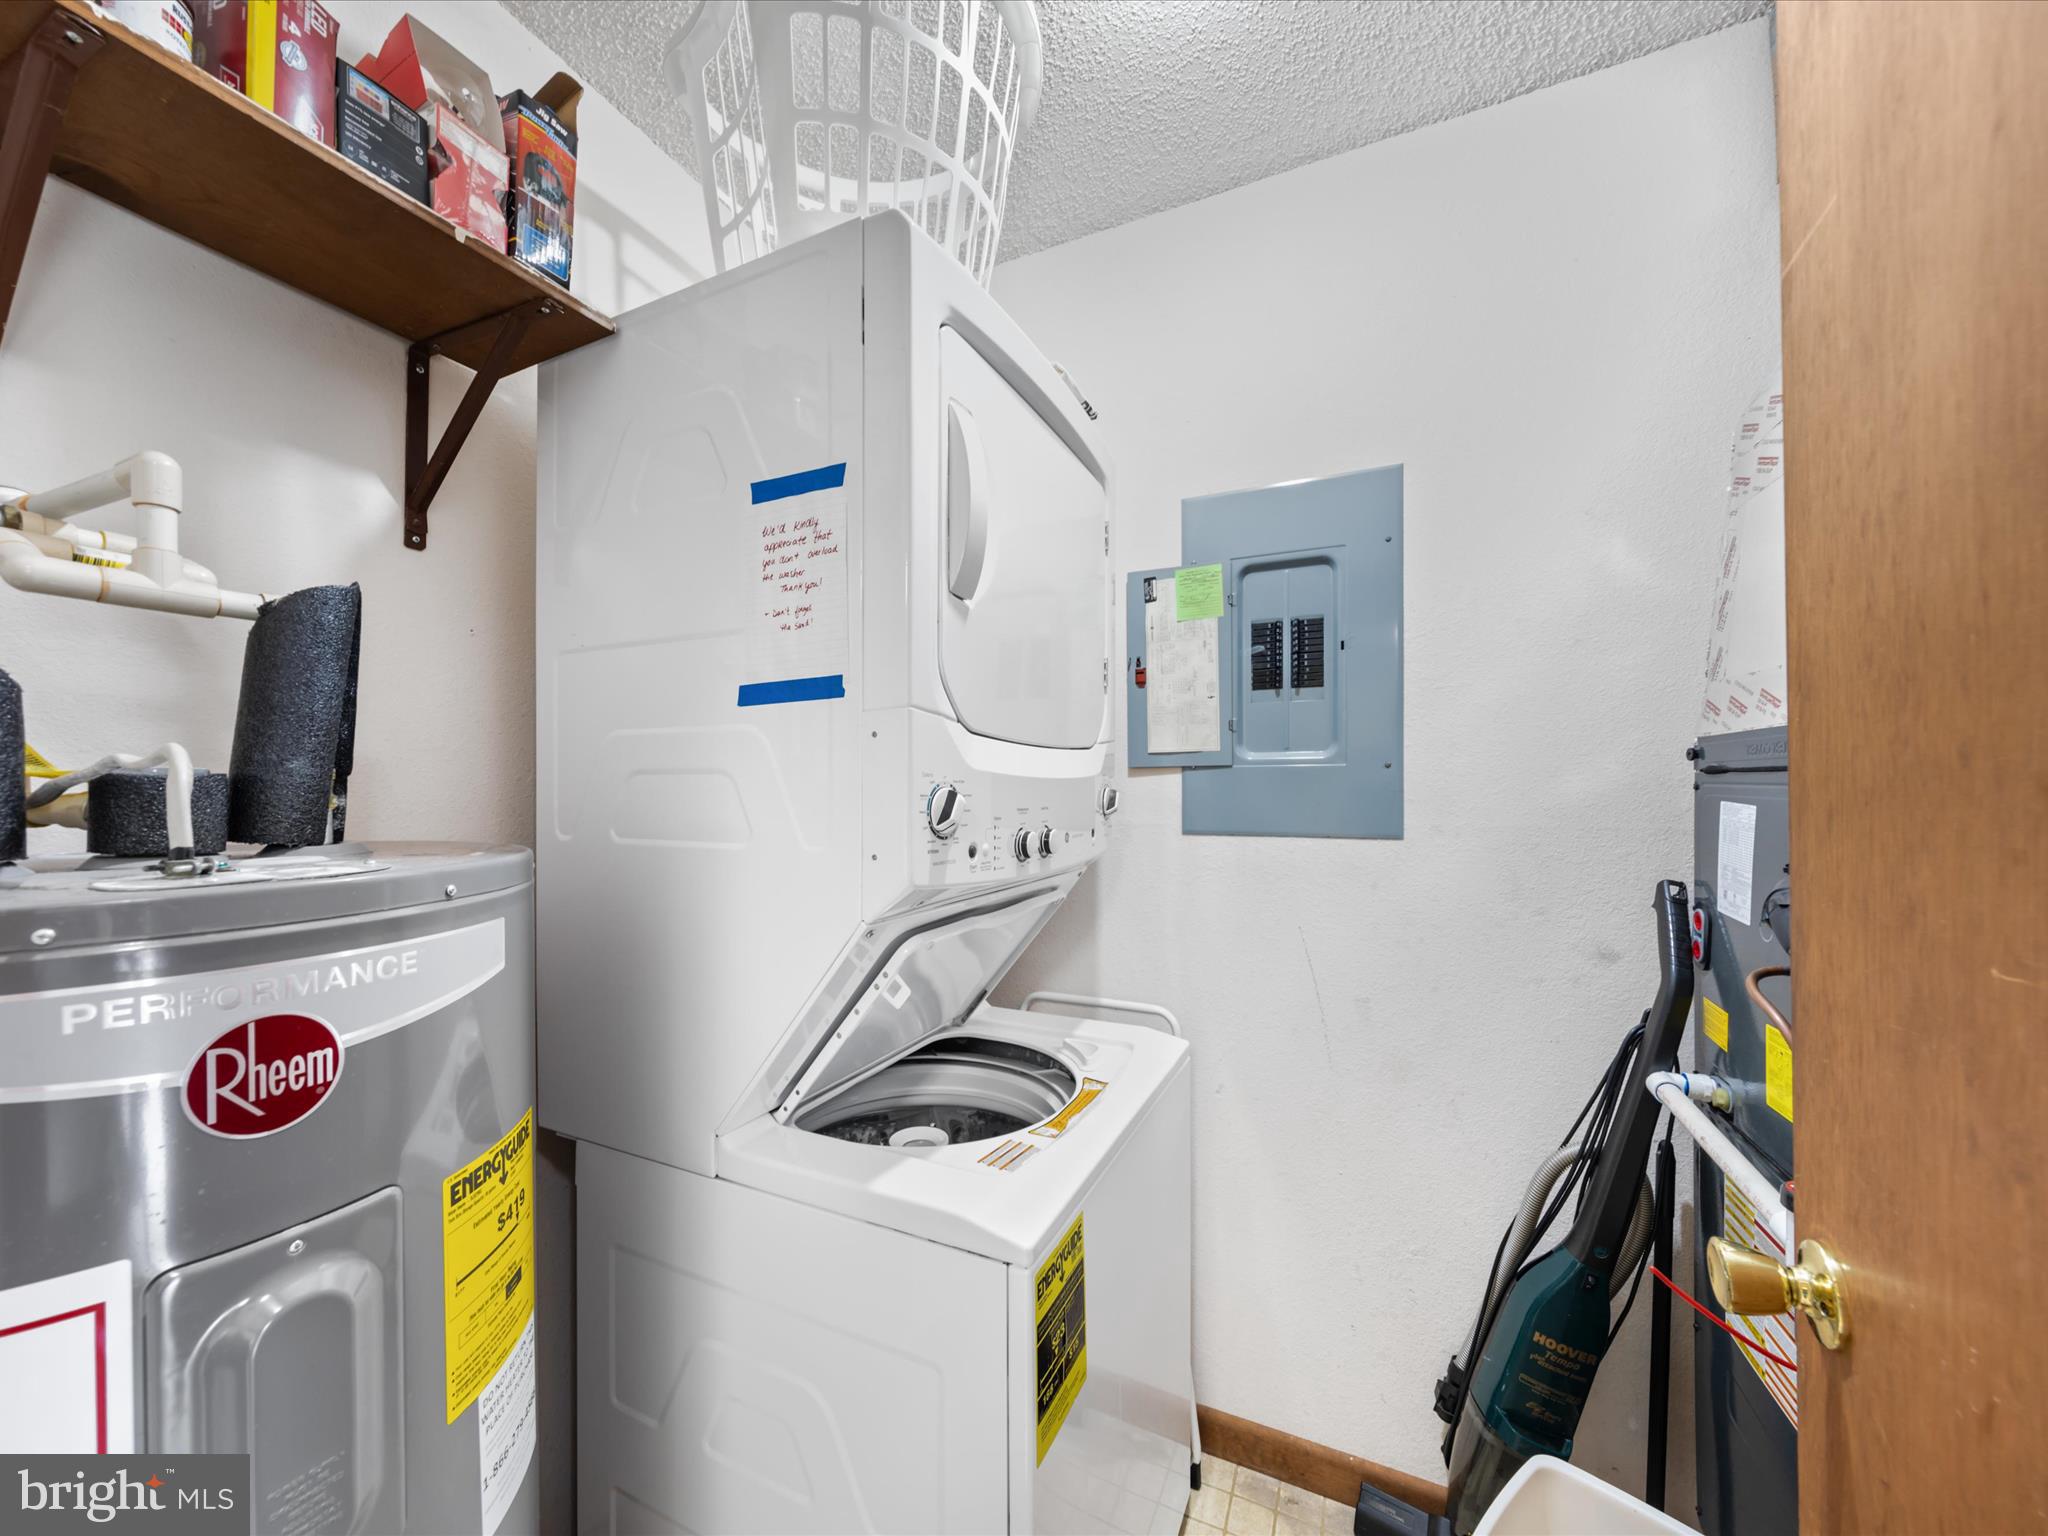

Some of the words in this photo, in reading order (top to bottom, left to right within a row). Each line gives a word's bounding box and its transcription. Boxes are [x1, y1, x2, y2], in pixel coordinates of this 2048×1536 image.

[536, 107, 550, 122] Jig
[550, 118, 568, 137] Saw
[813, 528, 833, 543] that
[762, 559, 775, 572] you
[779, 568, 805, 579] washer
[61, 949, 420, 1036] PERFORMANCE
[205, 1021, 335, 1126] Rheem
[1532, 1331, 1597, 1366] HOOVER
